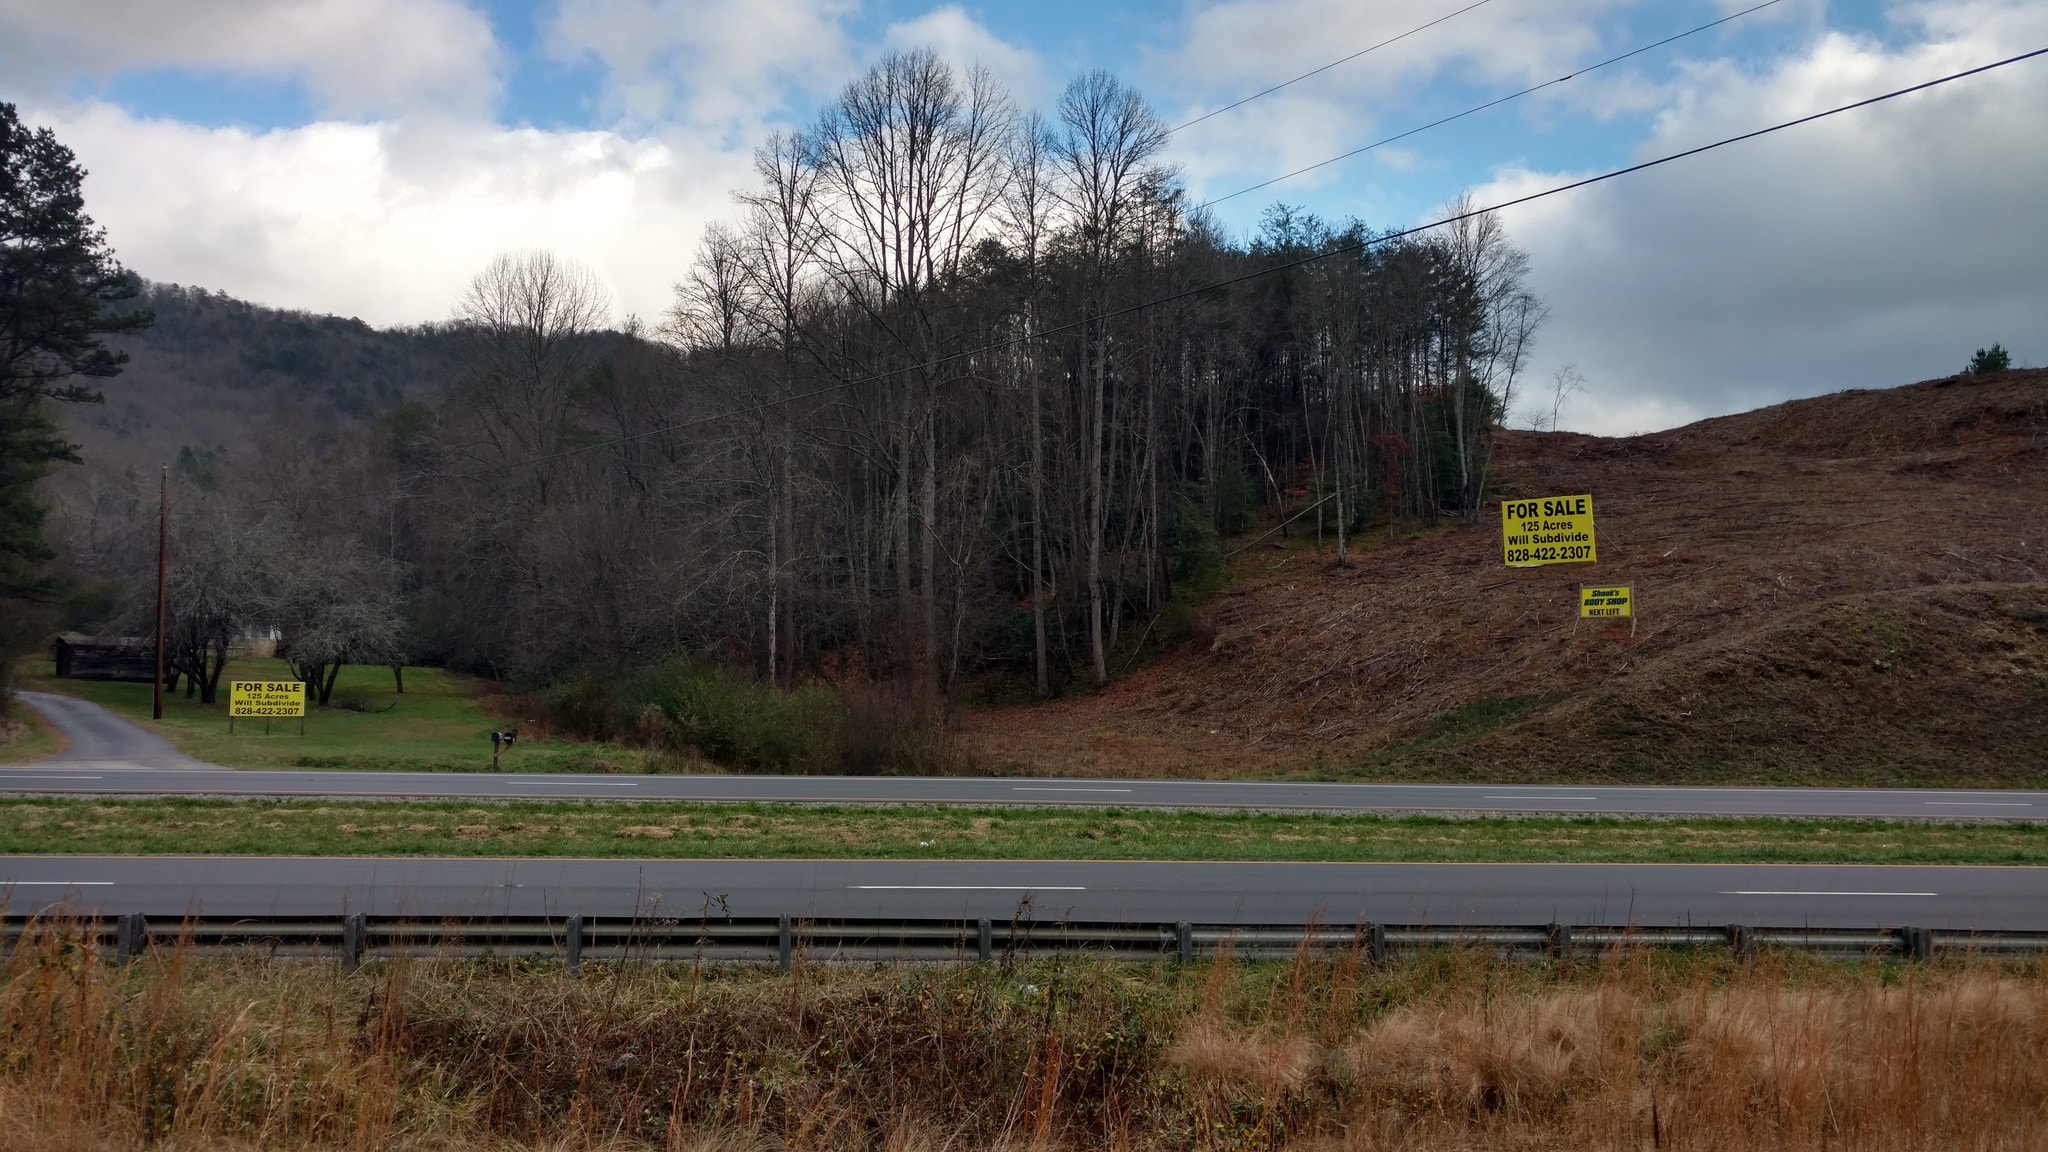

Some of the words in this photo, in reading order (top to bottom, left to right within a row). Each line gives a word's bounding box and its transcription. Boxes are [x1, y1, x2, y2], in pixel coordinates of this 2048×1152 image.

[1507, 503, 1539, 519] FOR
[1544, 499, 1586, 517] SALE
[1521, 521, 1539, 532] 125
[1543, 520, 1573, 531] Acres
[1508, 535, 1529, 545] Will
[1532, 532, 1589, 544] Subdivide
[1507, 545, 1591, 562] 828-422-2307
[1584, 598, 1605, 606] BODY
[1606, 597, 1628, 605] SHOP
[1588, 608, 1605, 616] NEXT
[1606, 608, 1620, 616] LEFT
[236, 683, 262, 692] FOR
[267, 683, 300, 692] SALE
[235, 707, 300, 715] 828-422-2307
